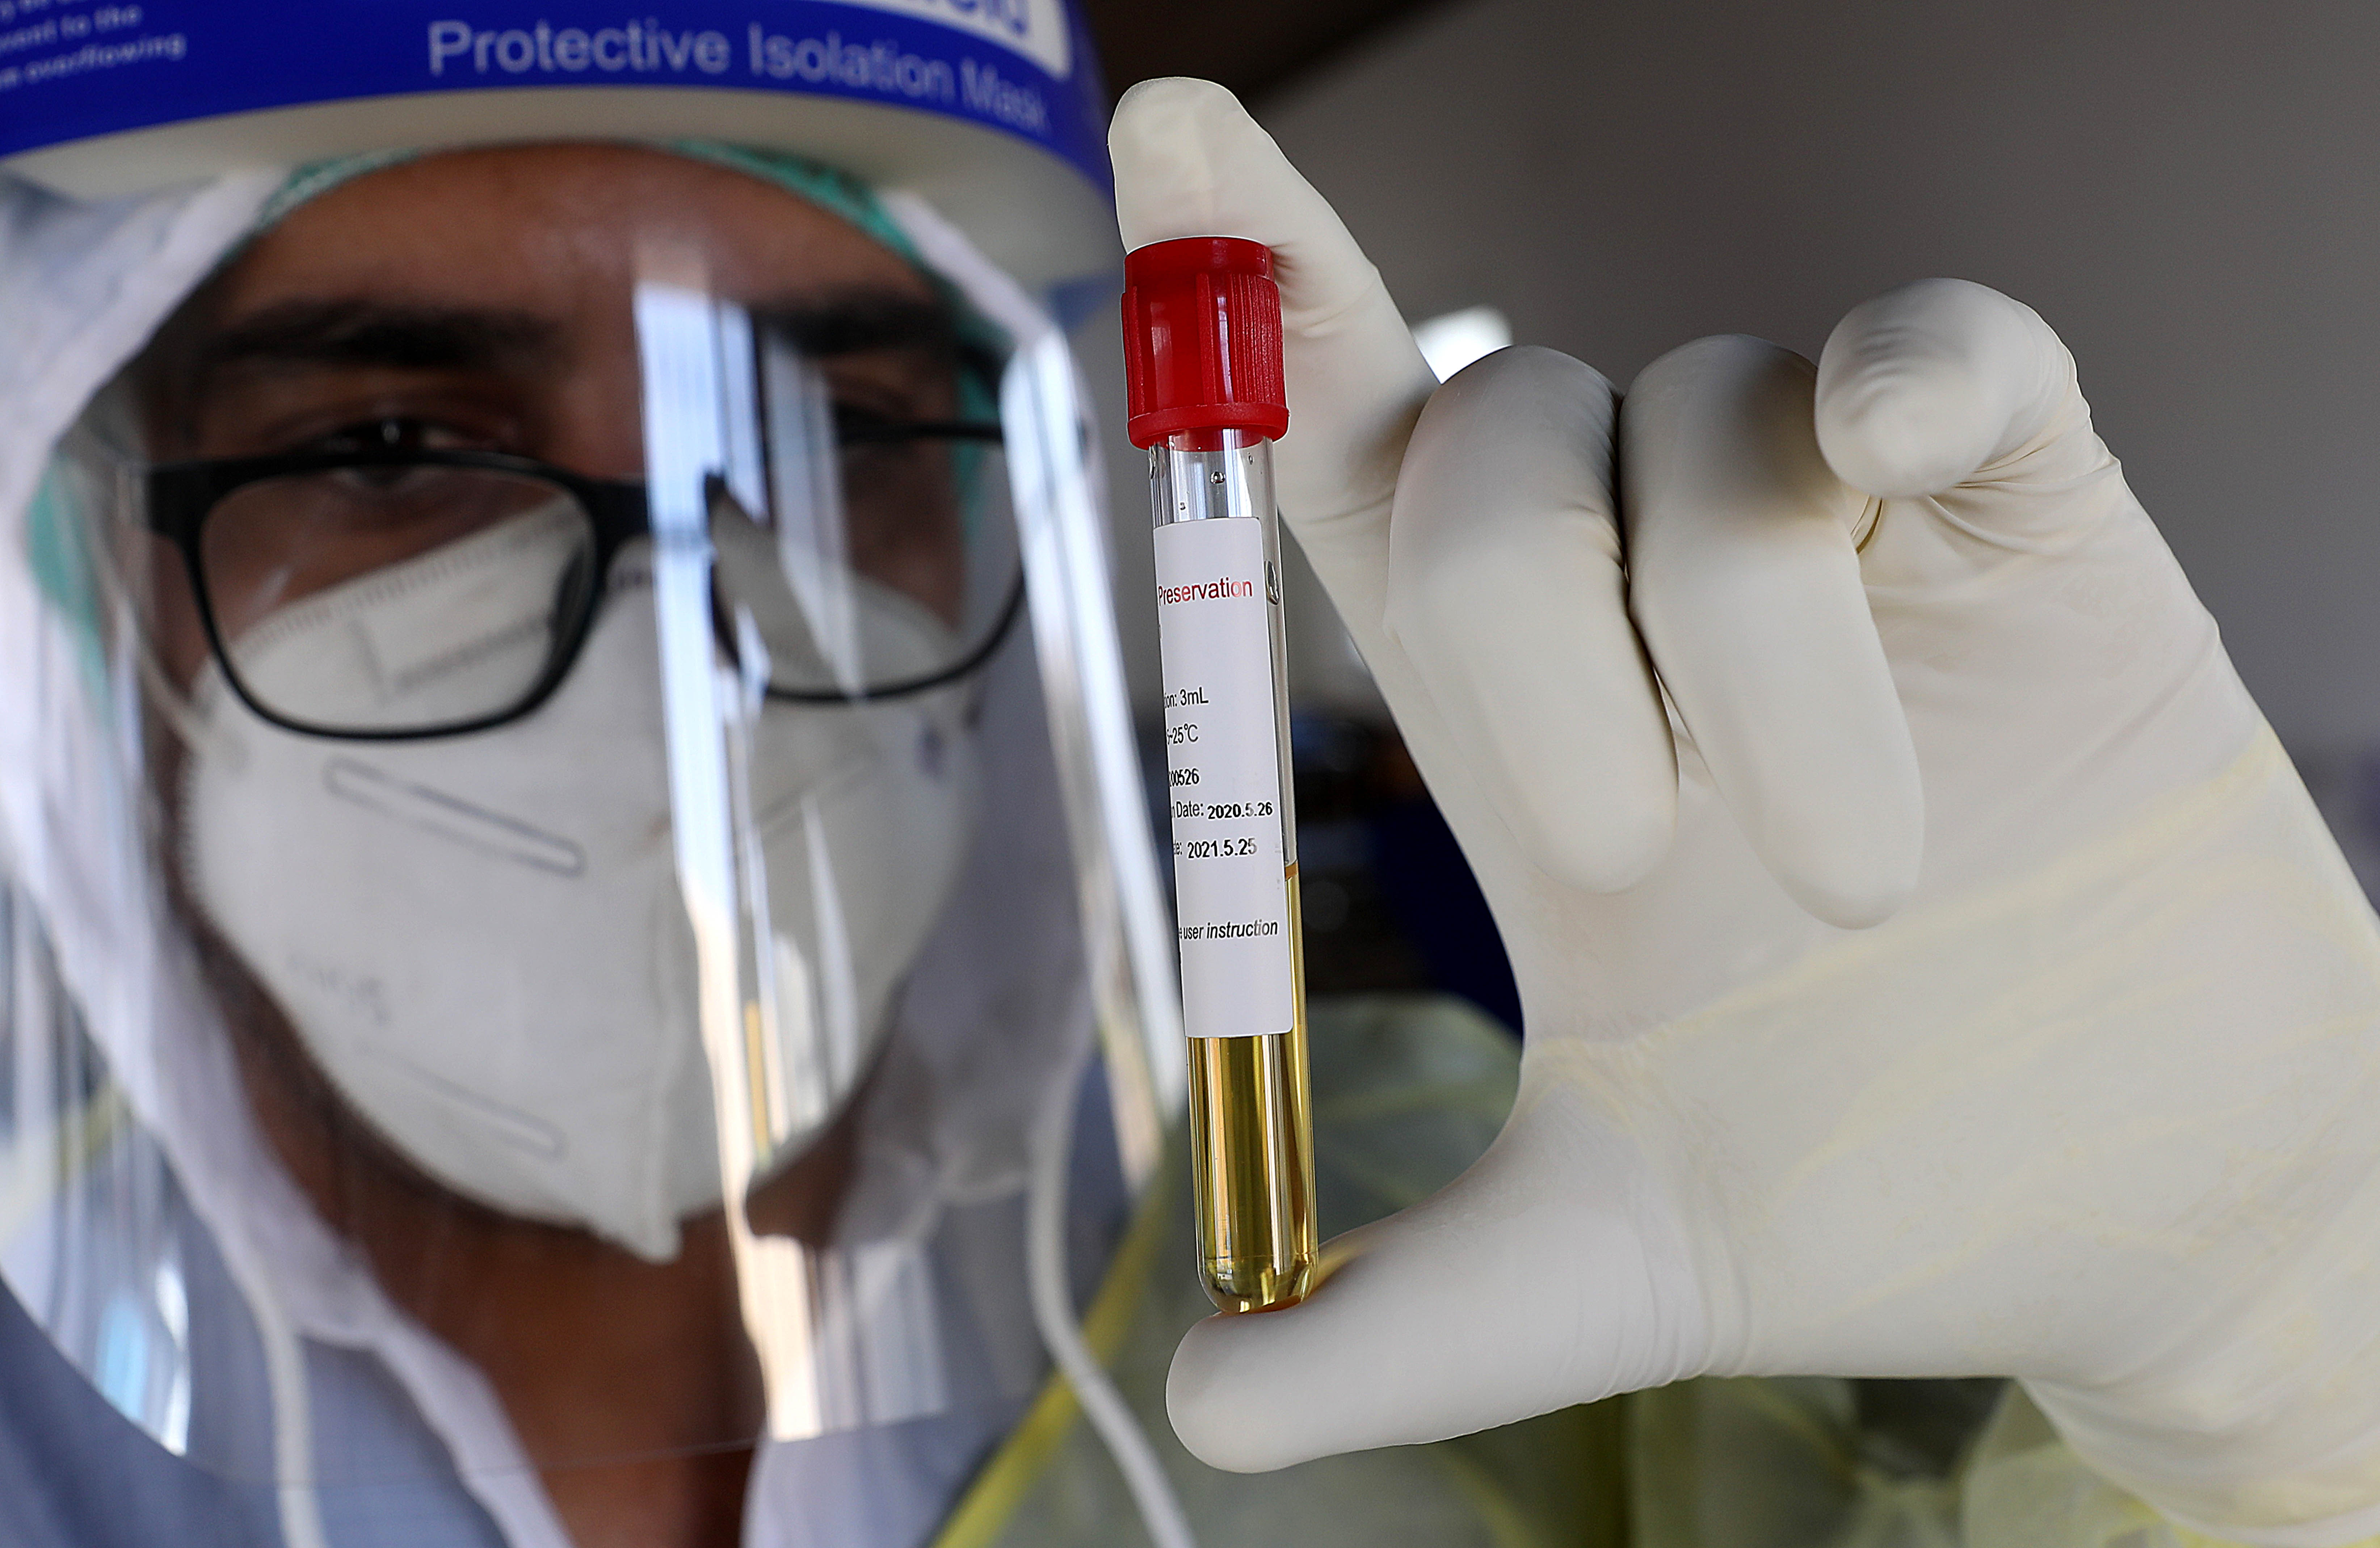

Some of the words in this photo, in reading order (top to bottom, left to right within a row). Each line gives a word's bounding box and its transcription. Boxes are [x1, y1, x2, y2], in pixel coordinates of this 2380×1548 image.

[428, 17, 731, 75] Protective
[748, 20, 956, 104] Isolation
[1158, 577, 1253, 606] Preservation
[1180, 687, 1209, 706] 3mL
[1177, 800, 1204, 818] Date:
[1207, 802, 1273, 819] 2020.5.26
[1187, 837, 1258, 859] 2021.5.25
[1183, 926, 1204, 939] user
[1207, 918, 1278, 939] instruction
